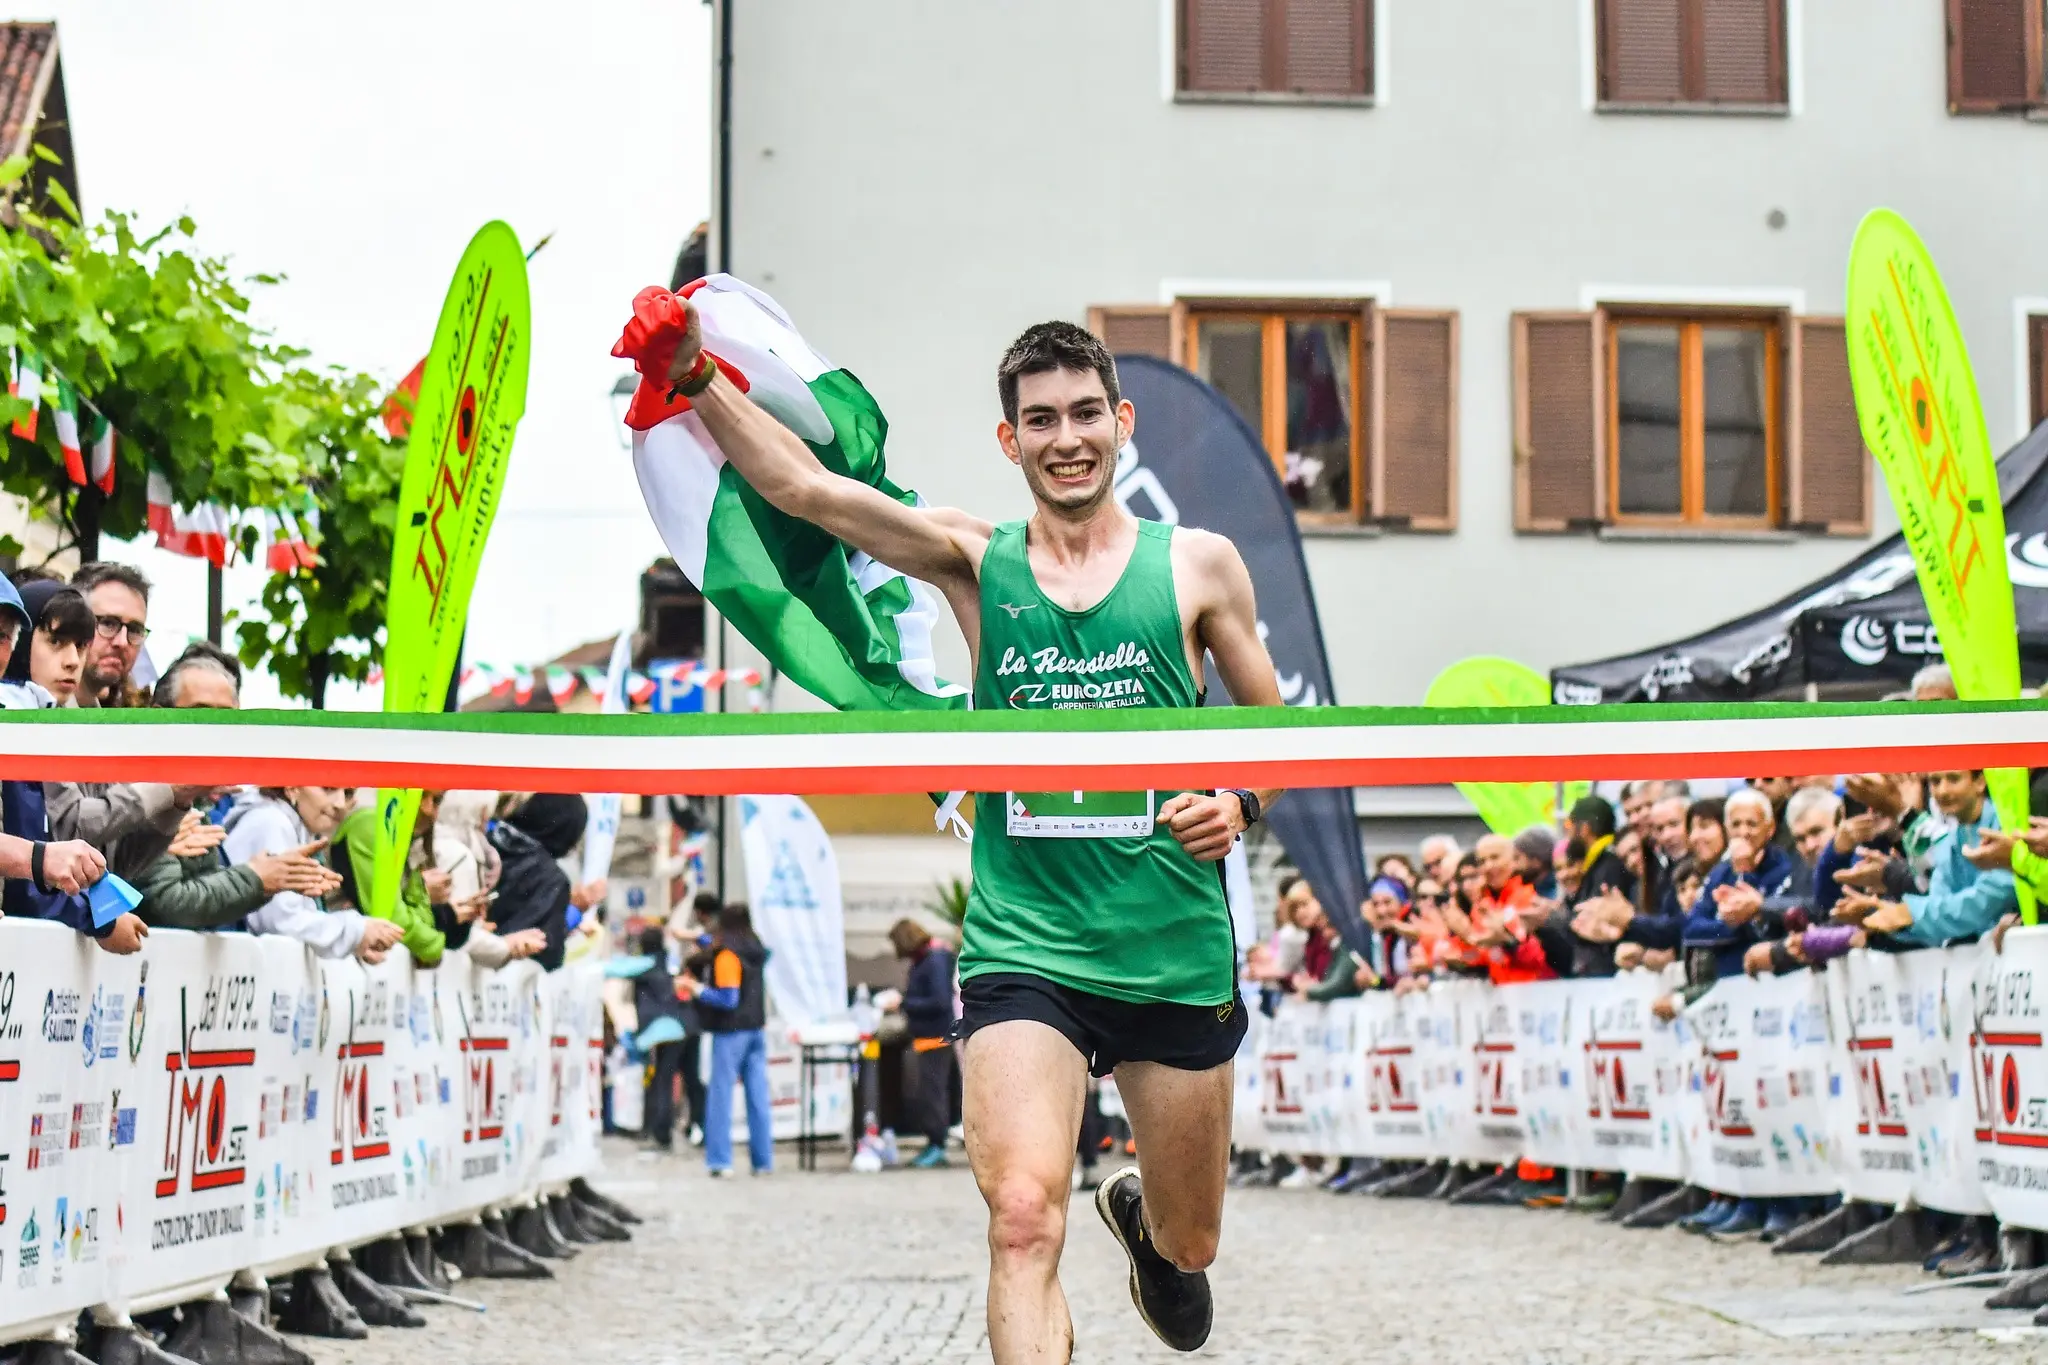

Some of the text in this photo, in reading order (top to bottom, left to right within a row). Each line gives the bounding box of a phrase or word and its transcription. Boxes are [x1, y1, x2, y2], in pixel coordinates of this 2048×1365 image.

[997, 641, 1150, 676] La Recastello
[1051, 678, 1146, 700] EUROZETA
[1052, 695, 1147, 711] CARPENTERIA METALLICA
